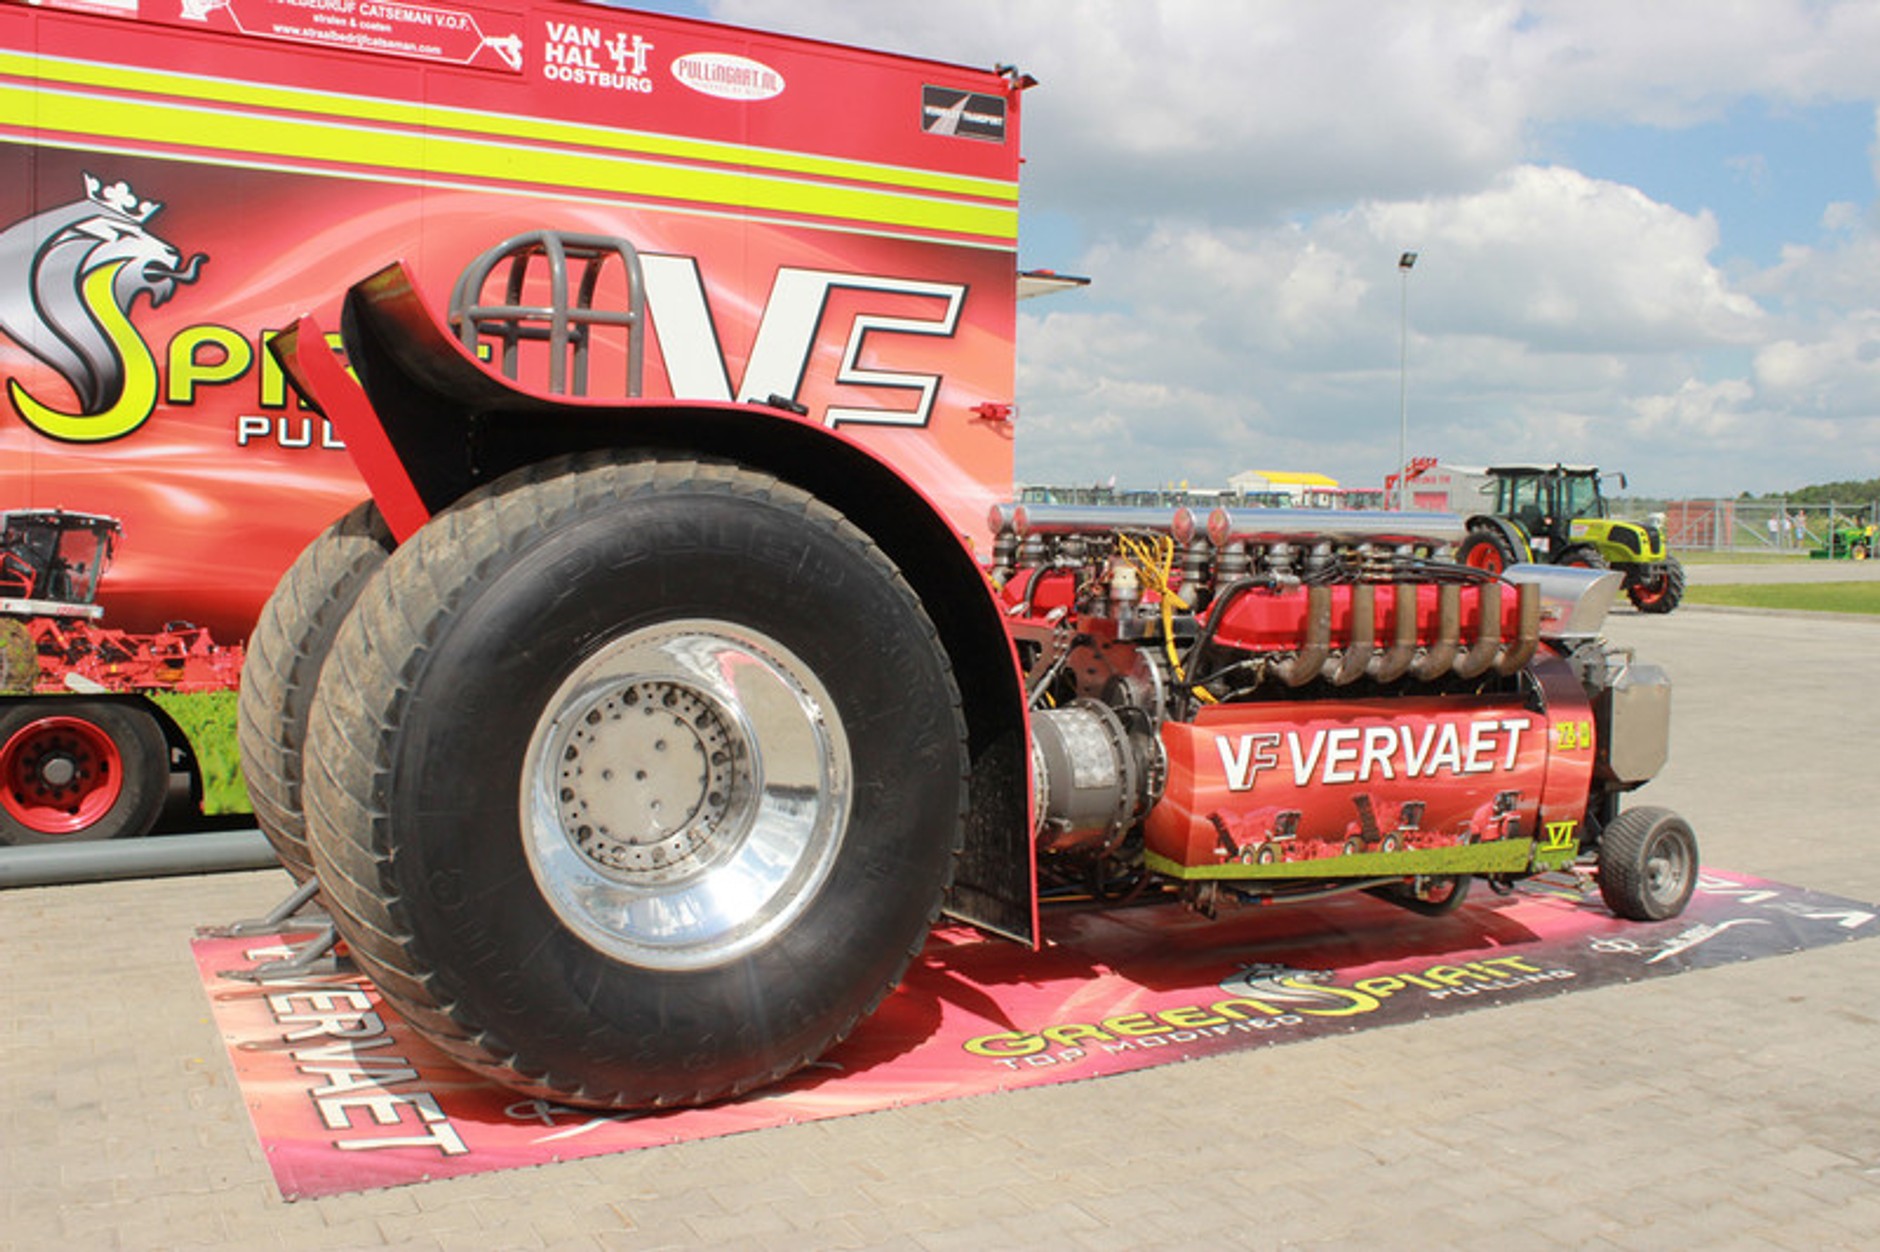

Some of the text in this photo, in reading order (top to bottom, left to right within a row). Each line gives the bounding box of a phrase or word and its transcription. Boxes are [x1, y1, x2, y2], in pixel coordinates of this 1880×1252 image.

[359, 2, 433, 26] CATSEMAN
[545, 20, 600, 49] VAN
[545, 41, 600, 69] HAL
[543, 63, 653, 93] OOSTBURG
[1287, 718, 1530, 786] VERVAET
[963, 998, 1286, 1058] GREEN
[993, 1013, 1303, 1070] TOP MODIFIED
